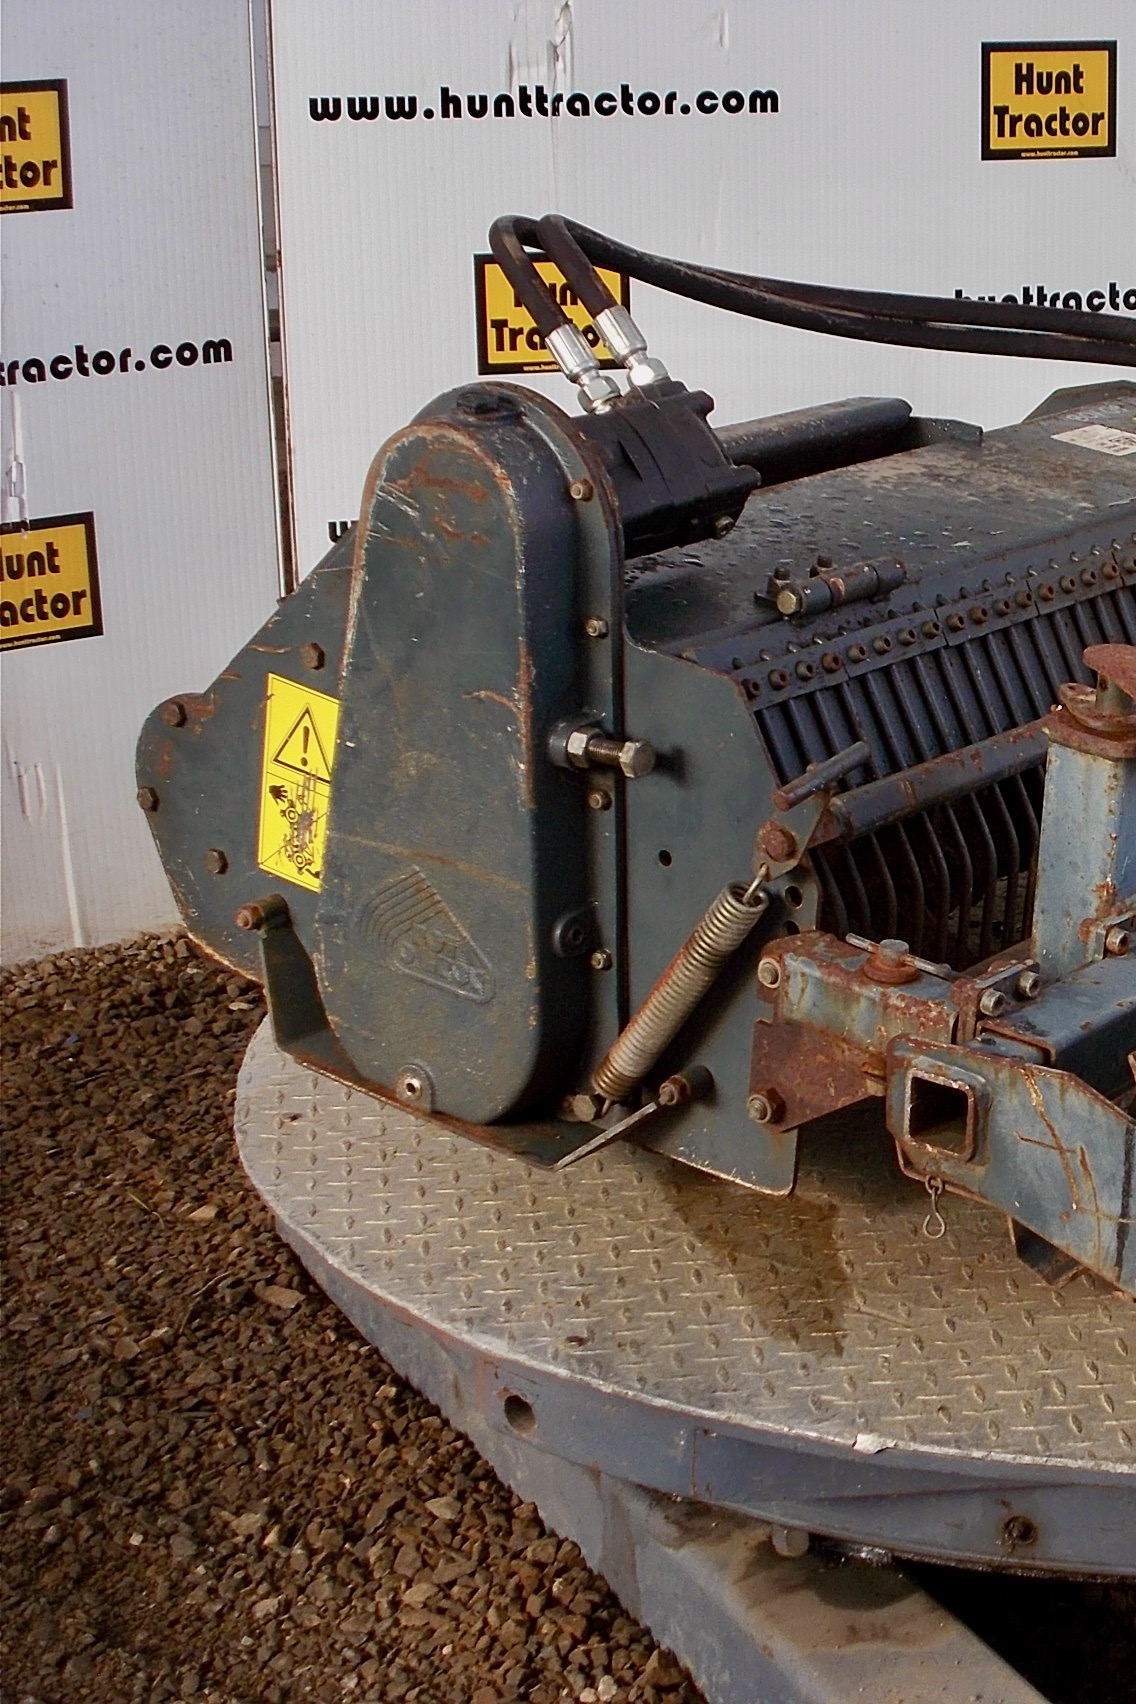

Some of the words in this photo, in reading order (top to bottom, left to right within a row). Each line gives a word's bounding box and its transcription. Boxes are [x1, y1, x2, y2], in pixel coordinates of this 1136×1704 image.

[1014, 62, 1084, 95] Hunt
[309, 84, 779, 121] www.hunttractor.com
[993, 105, 1105, 138] Tractor
[0, 542, 61, 581] unt
